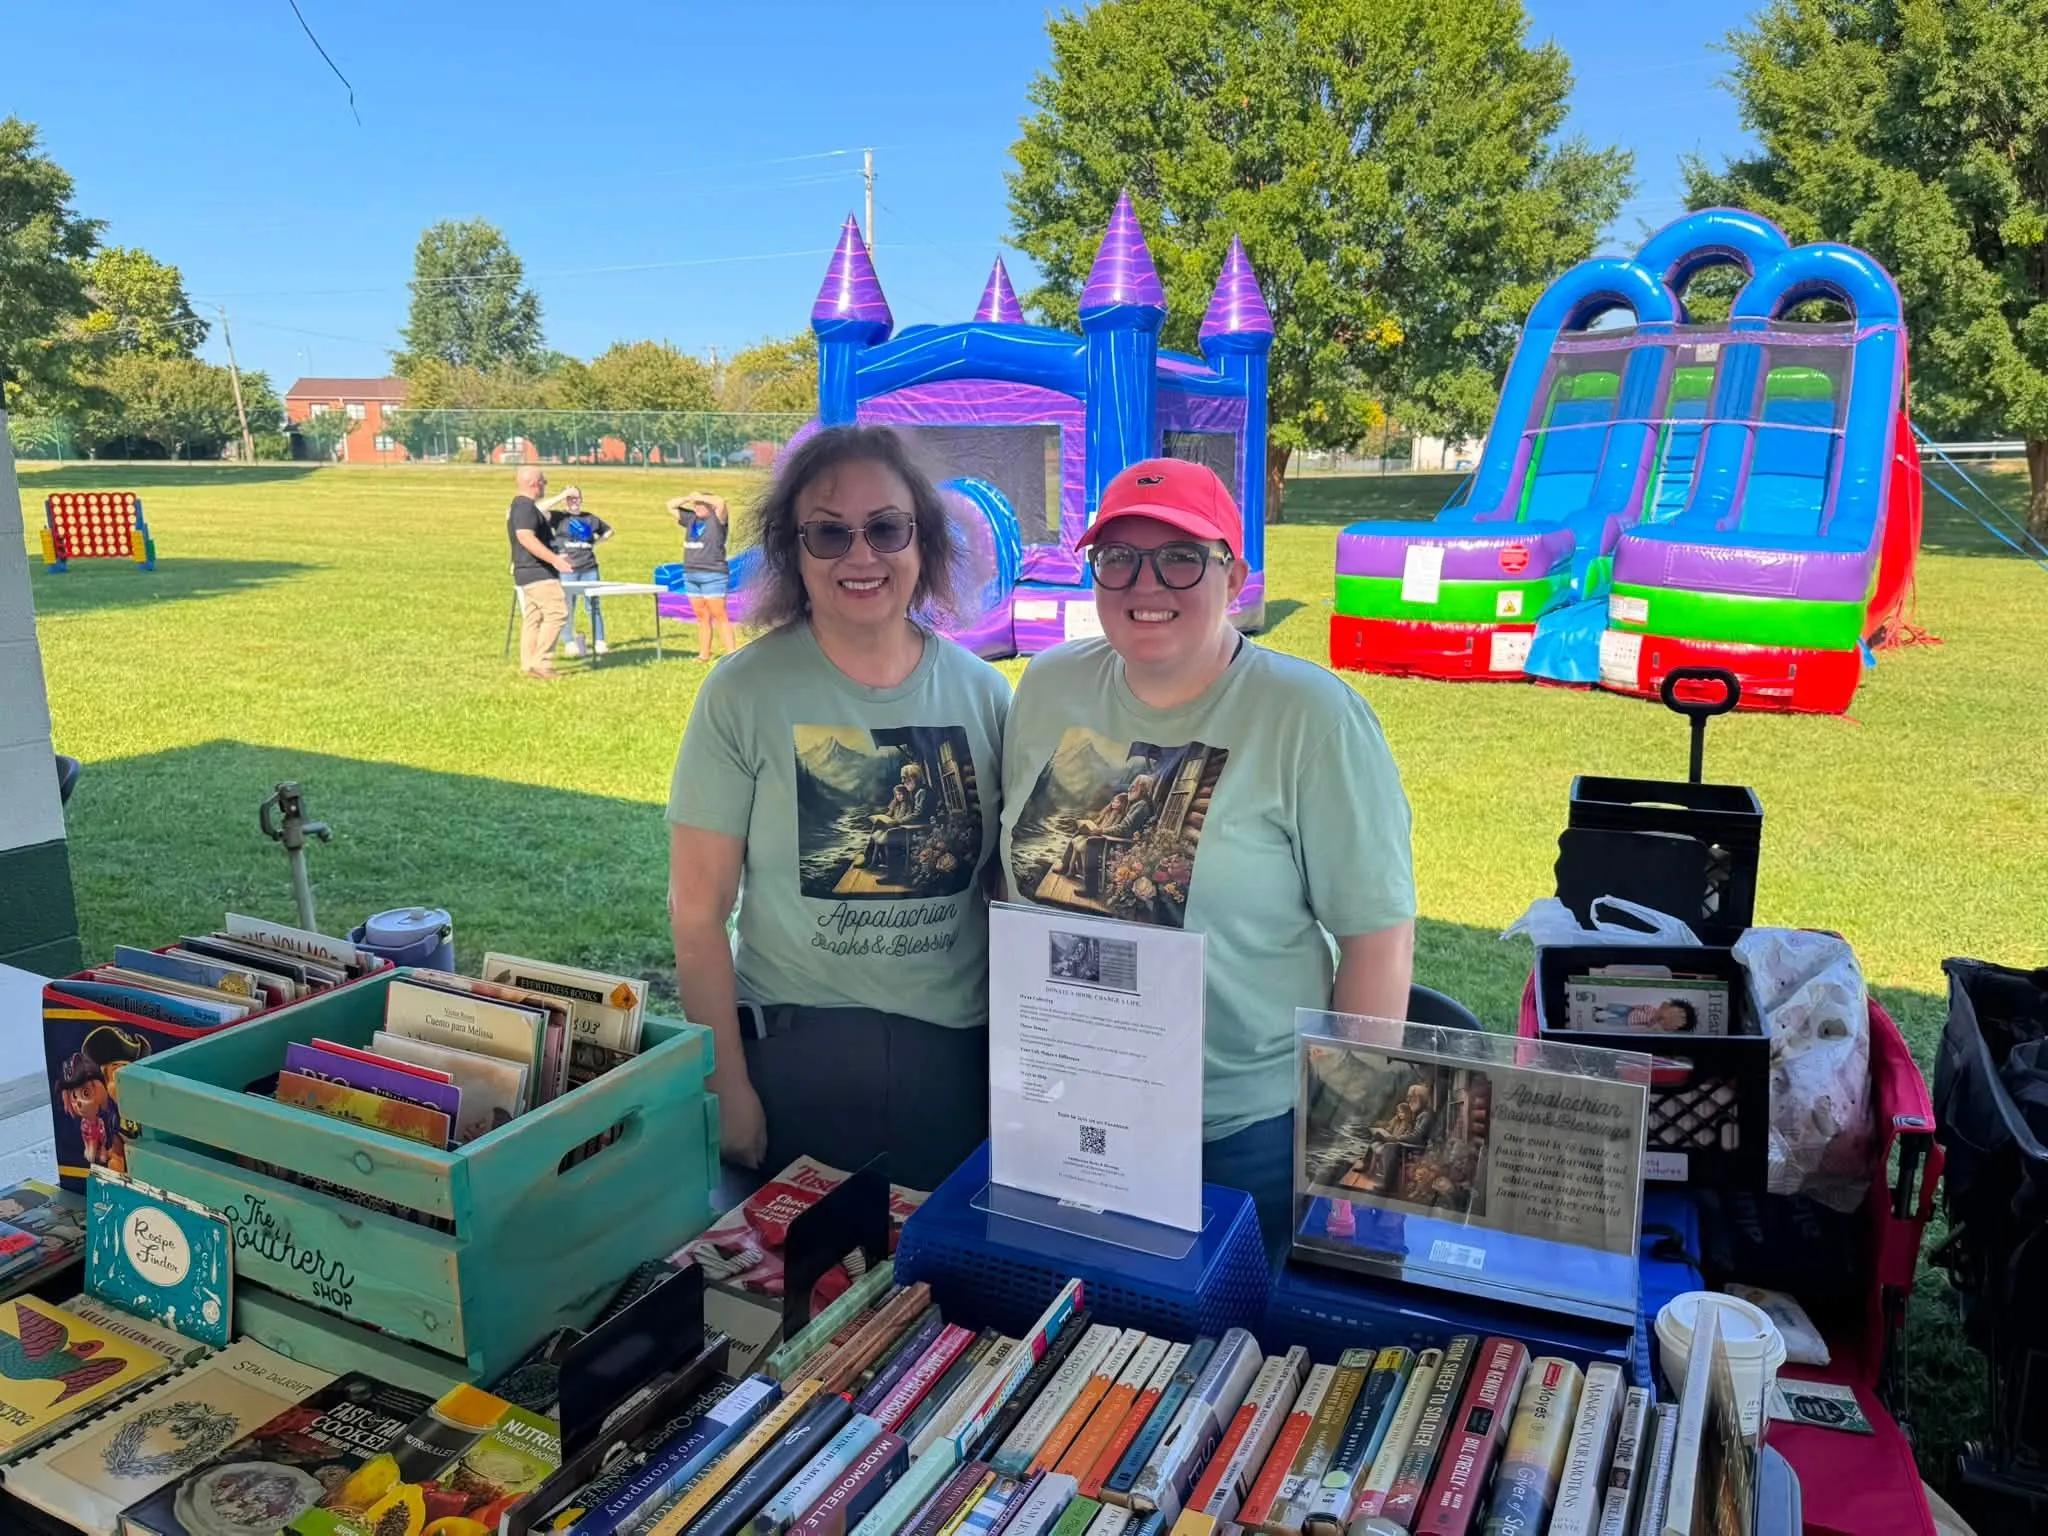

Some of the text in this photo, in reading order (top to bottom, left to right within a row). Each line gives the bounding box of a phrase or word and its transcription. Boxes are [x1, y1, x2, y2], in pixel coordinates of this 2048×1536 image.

[817, 902, 958, 936] Appalachian
[519, 978, 599, 1001] EYEWITNESS BOOKS
[425, 1014, 450, 1031] Cuento
[451, 1021, 468, 1036] para
[467, 1025, 494, 1041] Melissa
[1503, 1083, 1624, 1118] Appalachian
[1526, 1135, 1550, 1148] goal
[1553, 1140, 1561, 1150] is
[1495, 1146, 1628, 1176] passion for learning and
[1495, 1160, 1560, 1179] imagination
[1496, 1186, 1621, 1218] families as they rebuild
[1502, 1173, 1617, 1203] while also supporting
[244, 1194, 276, 1228] The
[1526, 1207, 1553, 1220] their
[134, 1218, 176, 1251] Recipe
[224, 1205, 355, 1289] Southern
[136, 1241, 180, 1274] Finder
[312, 1281, 353, 1310] SHOP
[152, 1340, 183, 1356] BOOK
[1063, 1329, 1104, 1385] JAN KARON
[1107, 1345, 1128, 1371] KARON
[233, 1360, 267, 1379] STAR
[917, 1351, 947, 1381] JAMES
[1134, 1354, 1151, 1381] KARON
[1157, 1354, 1178, 1385] KARON
[1477, 1342, 1512, 1406] KILLING KENNEDY
[876, 1375, 925, 1426] PATTERSON
[1254, 1373, 1271, 1400] KARON
[1264, 1393, 1278, 1410] YOUR
[1273, 1378, 1286, 1394] WITH
[1303, 1381, 1320, 1408] KARON
[1412, 1338, 1469, 1447] FROM SHEEP TO SOLDIER
[327, 1402, 372, 1428] FAST
[750, 1386, 811, 1445] PARABLES
[1254, 1408, 1268, 1427] ADULT
[1533, 1386, 1555, 1420] Moyes
[1581, 1382, 1605, 1432] MANAGING
[647, 1415, 692, 1449] Queen
[669, 1432, 705, 1462] two's
[1238, 1425, 1259, 1457] CHILDREN
[1575, 1430, 1593, 1461] YOUR
[494, 1431, 562, 1470] Natural Healing
[779, 1422, 862, 1507] INVINCIBLE MISS CUST
[1449, 1437, 1481, 1488] BILL O'REILLY
[1615, 1435, 1636, 1463] Strife
[605, 1462, 670, 1517] company
[804, 1439, 893, 1529] MADEMOISELLE
[1516, 1466, 1537, 1497] Giver
[1563, 1459, 1588, 1509] EMOTIONS
[1029, 1500, 1047, 1519] PAM
[1106, 1508, 1123, 1526] JAN
[1509, 1499, 1527, 1520] of
